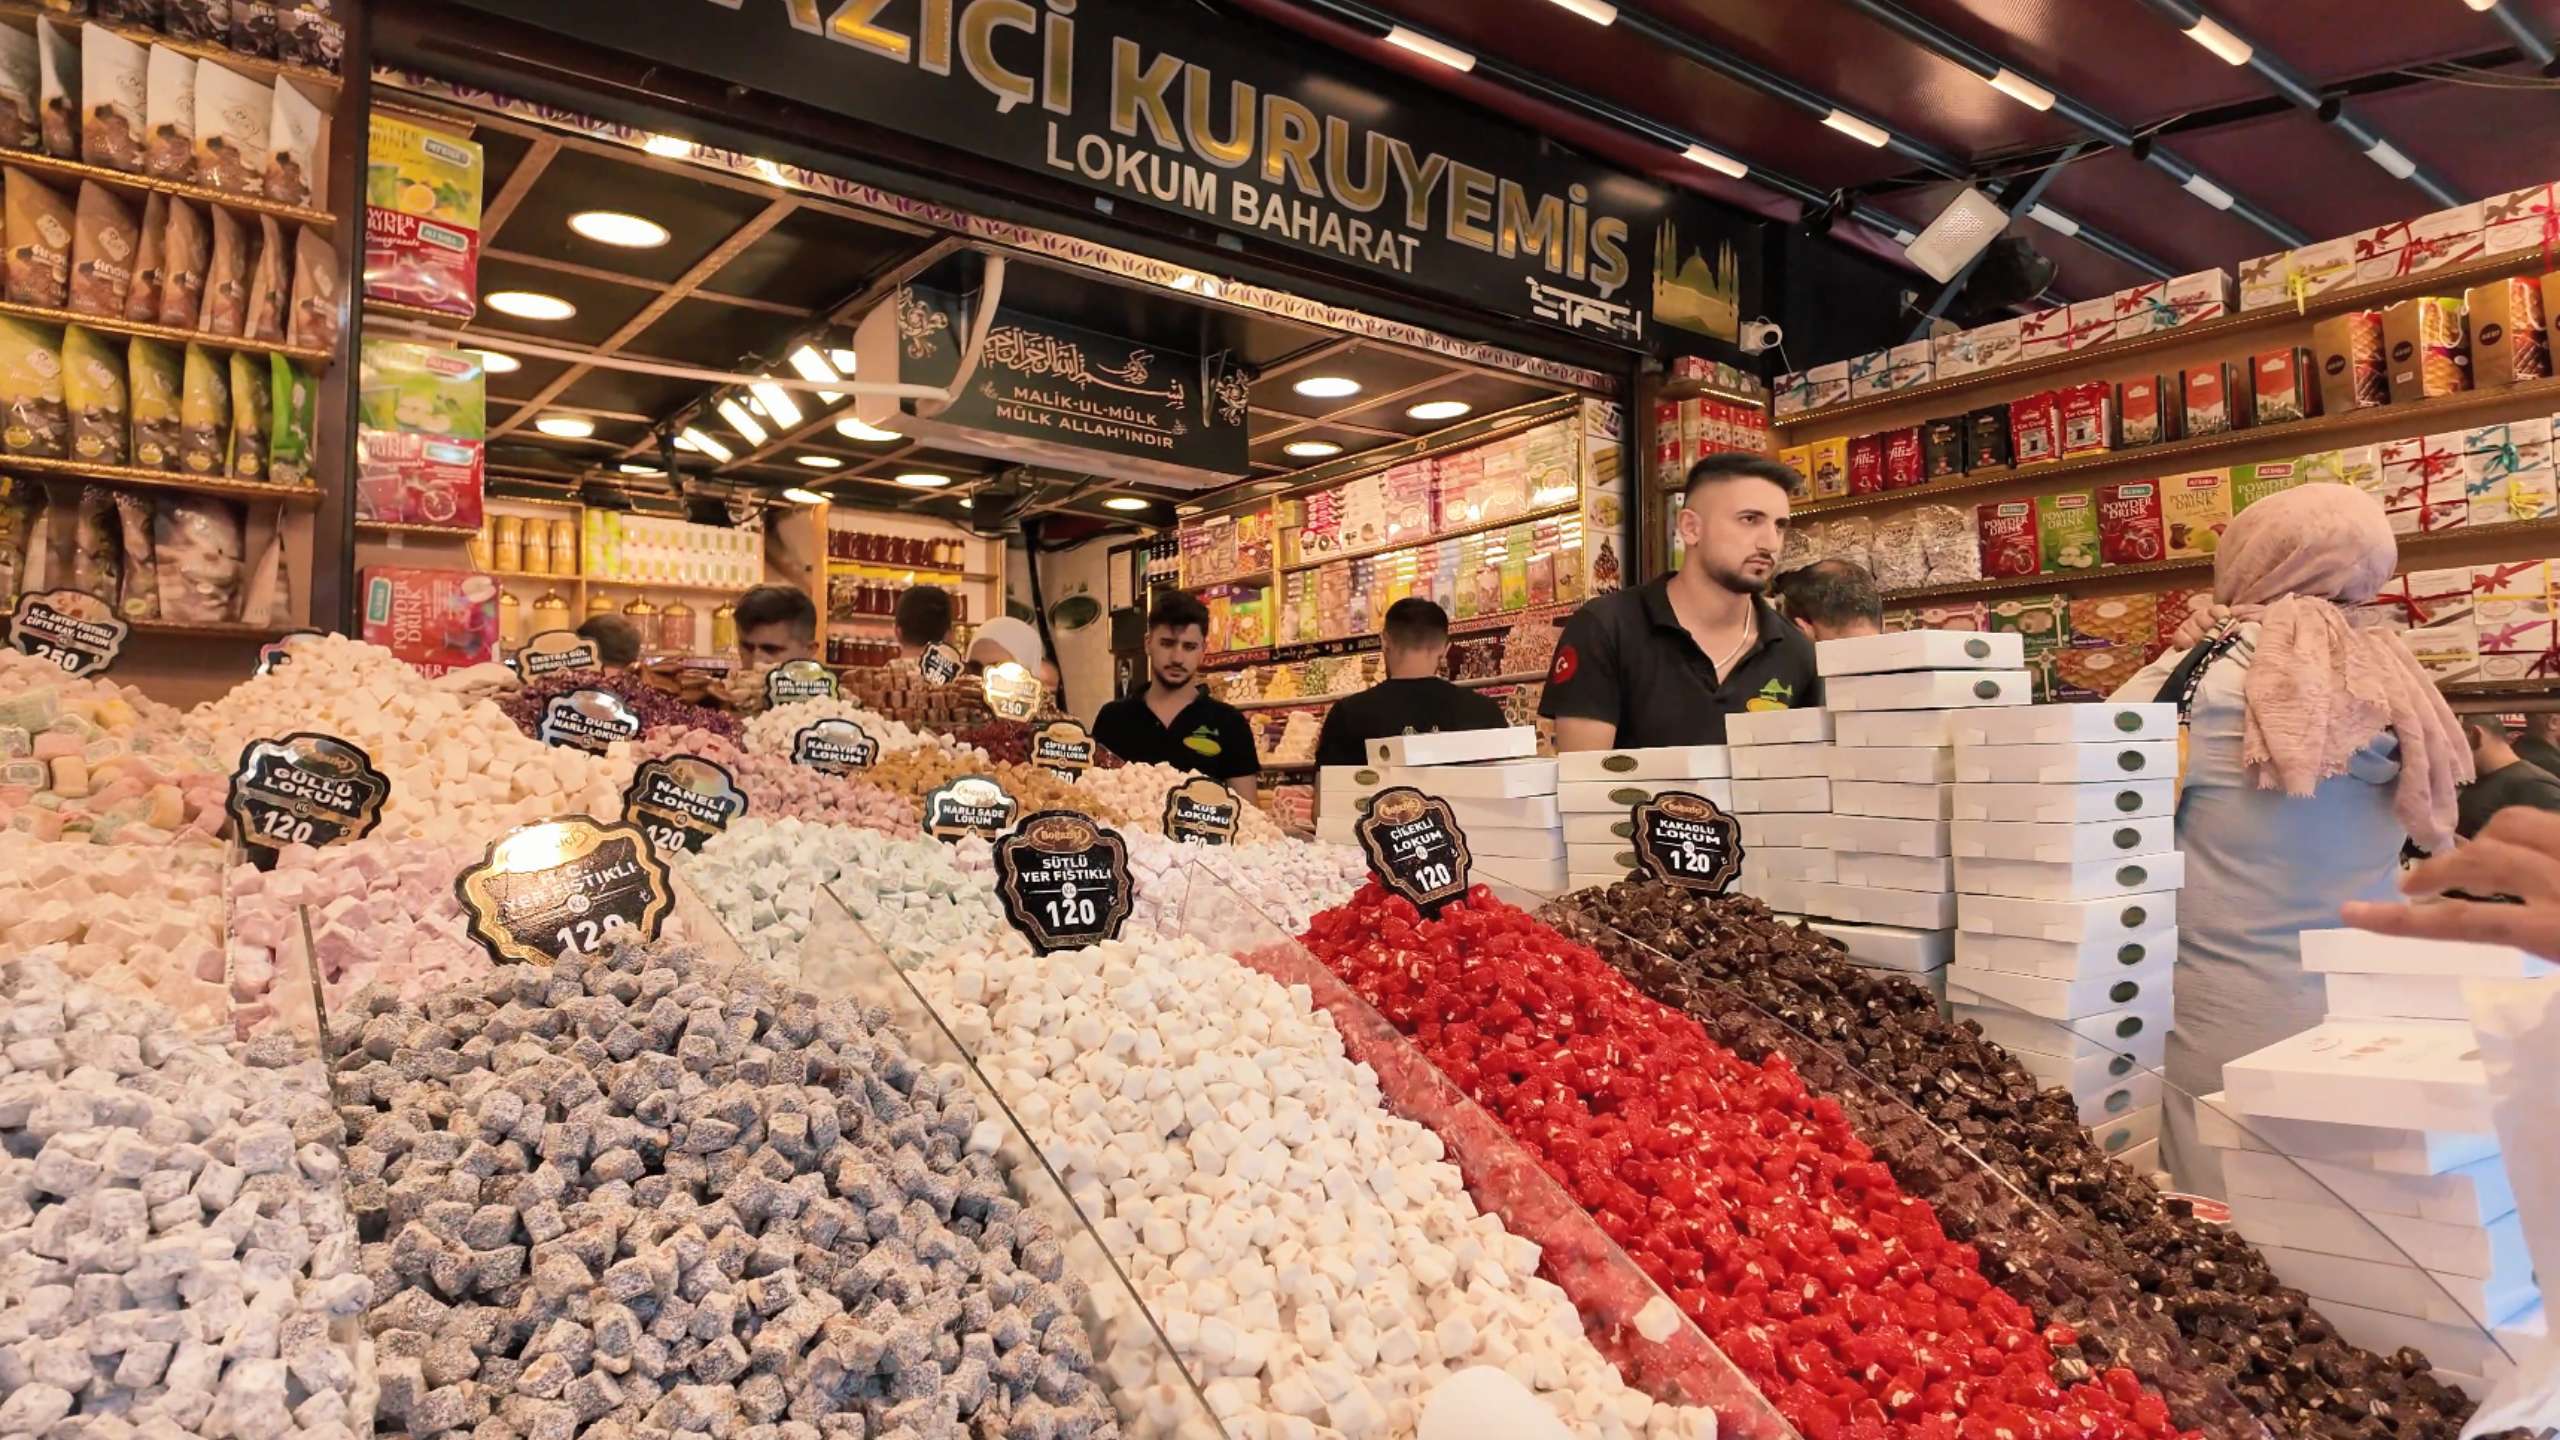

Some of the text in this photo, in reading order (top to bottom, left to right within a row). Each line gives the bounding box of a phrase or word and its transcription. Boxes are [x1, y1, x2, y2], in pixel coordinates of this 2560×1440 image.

[1110, 36, 1630, 299] KURUYEMİŞ
[1047, 121, 1420, 273] LOKUM BAHARAT
[996, 405, 1052, 427] MÜLK
[2103, 497, 2153, 513] POWDER
[2109, 506, 2148, 520] DRINK
[76, 631, 110, 648] LOKUM
[35, 643, 80, 672] 250
[588, 727, 626, 743] LOKUM
[811, 750, 863, 765] LOKUM
[263, 776, 353, 811] LOKUM
[273, 766, 354, 798] GÜLLÜ
[651, 791, 721, 823] LOKUM
[1177, 808, 1230, 825] LOKUMU
[263, 810, 314, 844] 120
[954, 813, 993, 826] LOKUM
[1660, 819, 1716, 835] KAKAOLU
[646, 824, 687, 852] 120
[1393, 830, 1444, 854] LOKUM
[1655, 827, 1721, 846] LOKUM
[1042, 854, 1089, 870] SÜTLÜ
[1670, 850, 1711, 874] 120
[1021, 867, 1112, 883] YER FISTIKLI
[1415, 863, 1452, 892] 120
[1045, 898, 1097, 928] 120
